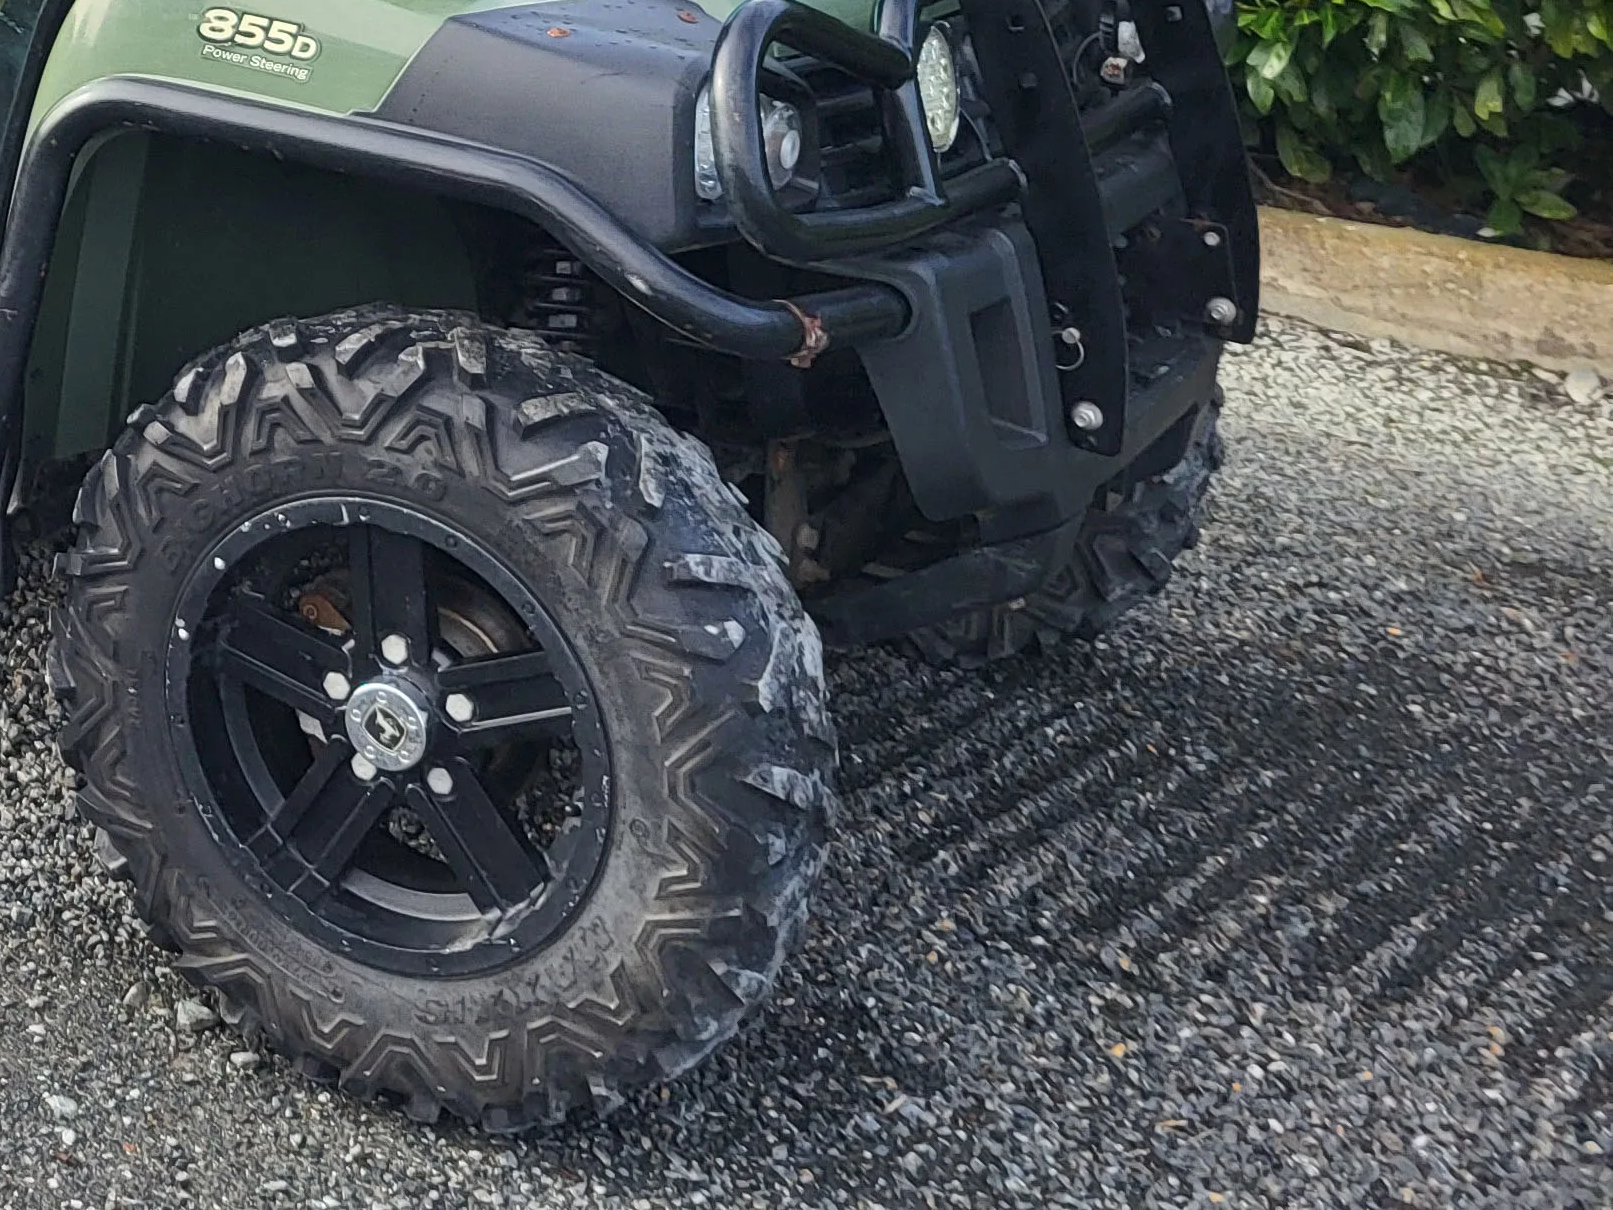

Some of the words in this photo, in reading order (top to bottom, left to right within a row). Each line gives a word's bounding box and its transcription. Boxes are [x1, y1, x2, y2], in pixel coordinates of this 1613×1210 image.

[198, 7, 319, 60] 855D
[202, 44, 248, 64] Power
[249, 55, 309, 80] Steering
